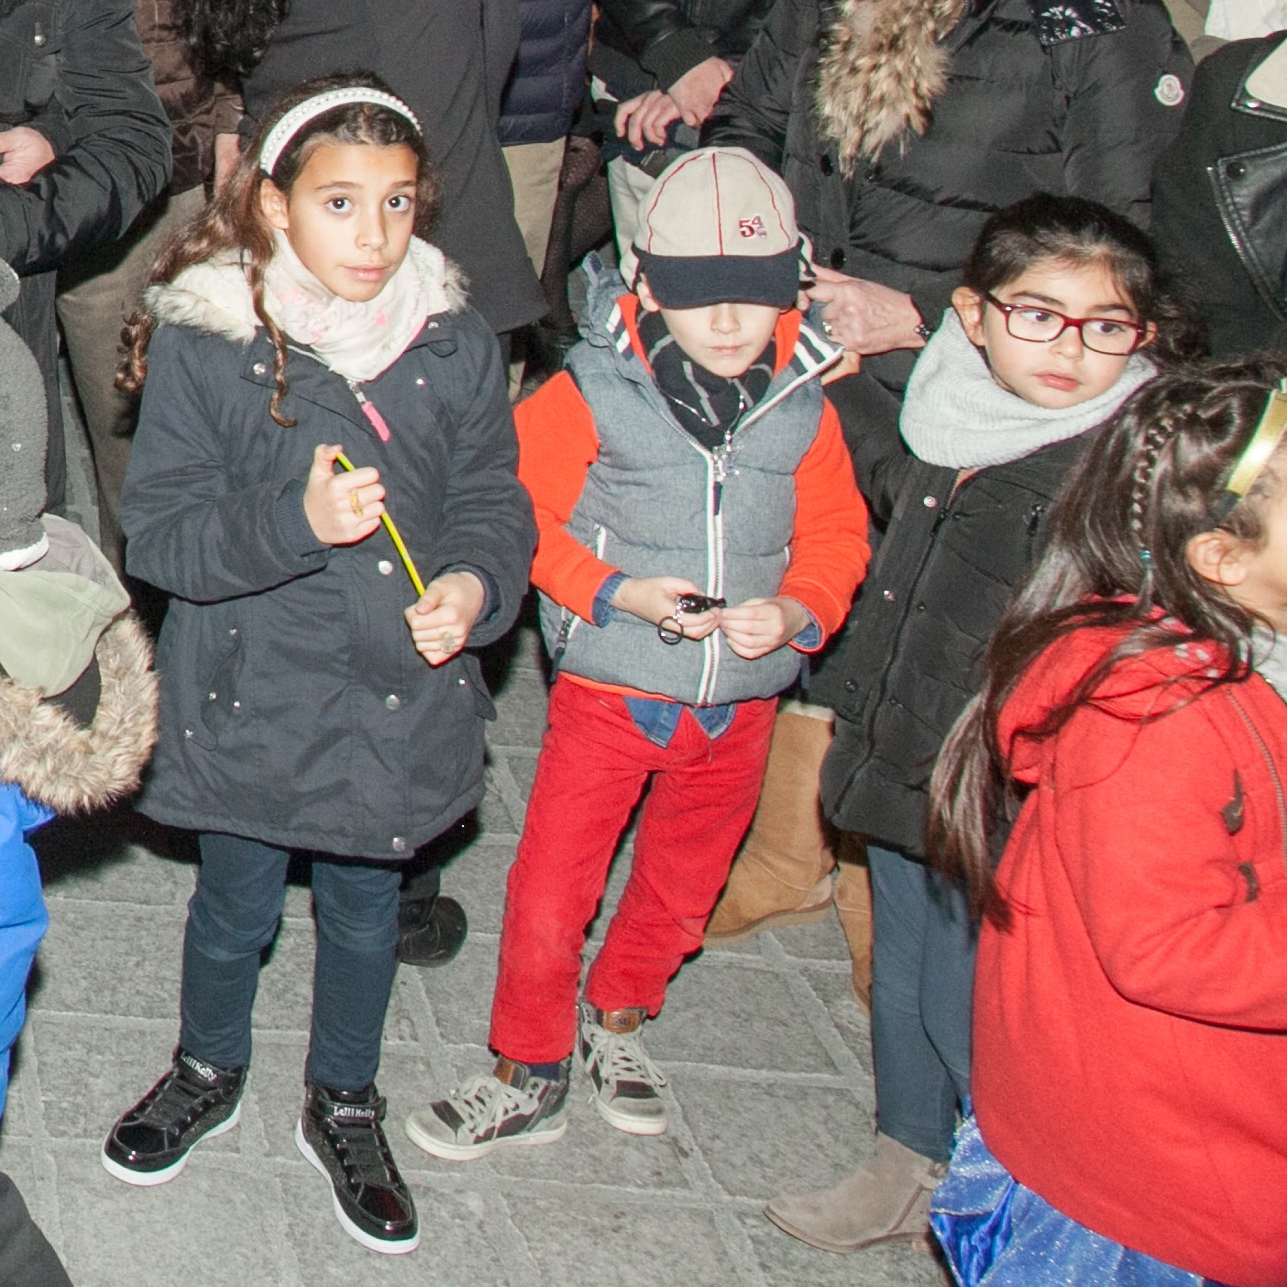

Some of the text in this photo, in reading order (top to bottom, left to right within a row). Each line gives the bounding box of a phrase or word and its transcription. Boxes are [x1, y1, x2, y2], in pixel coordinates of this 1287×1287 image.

[195, 1061, 217, 1082] Kelly
[333, 1105, 375, 1119] Lelli Kelly
